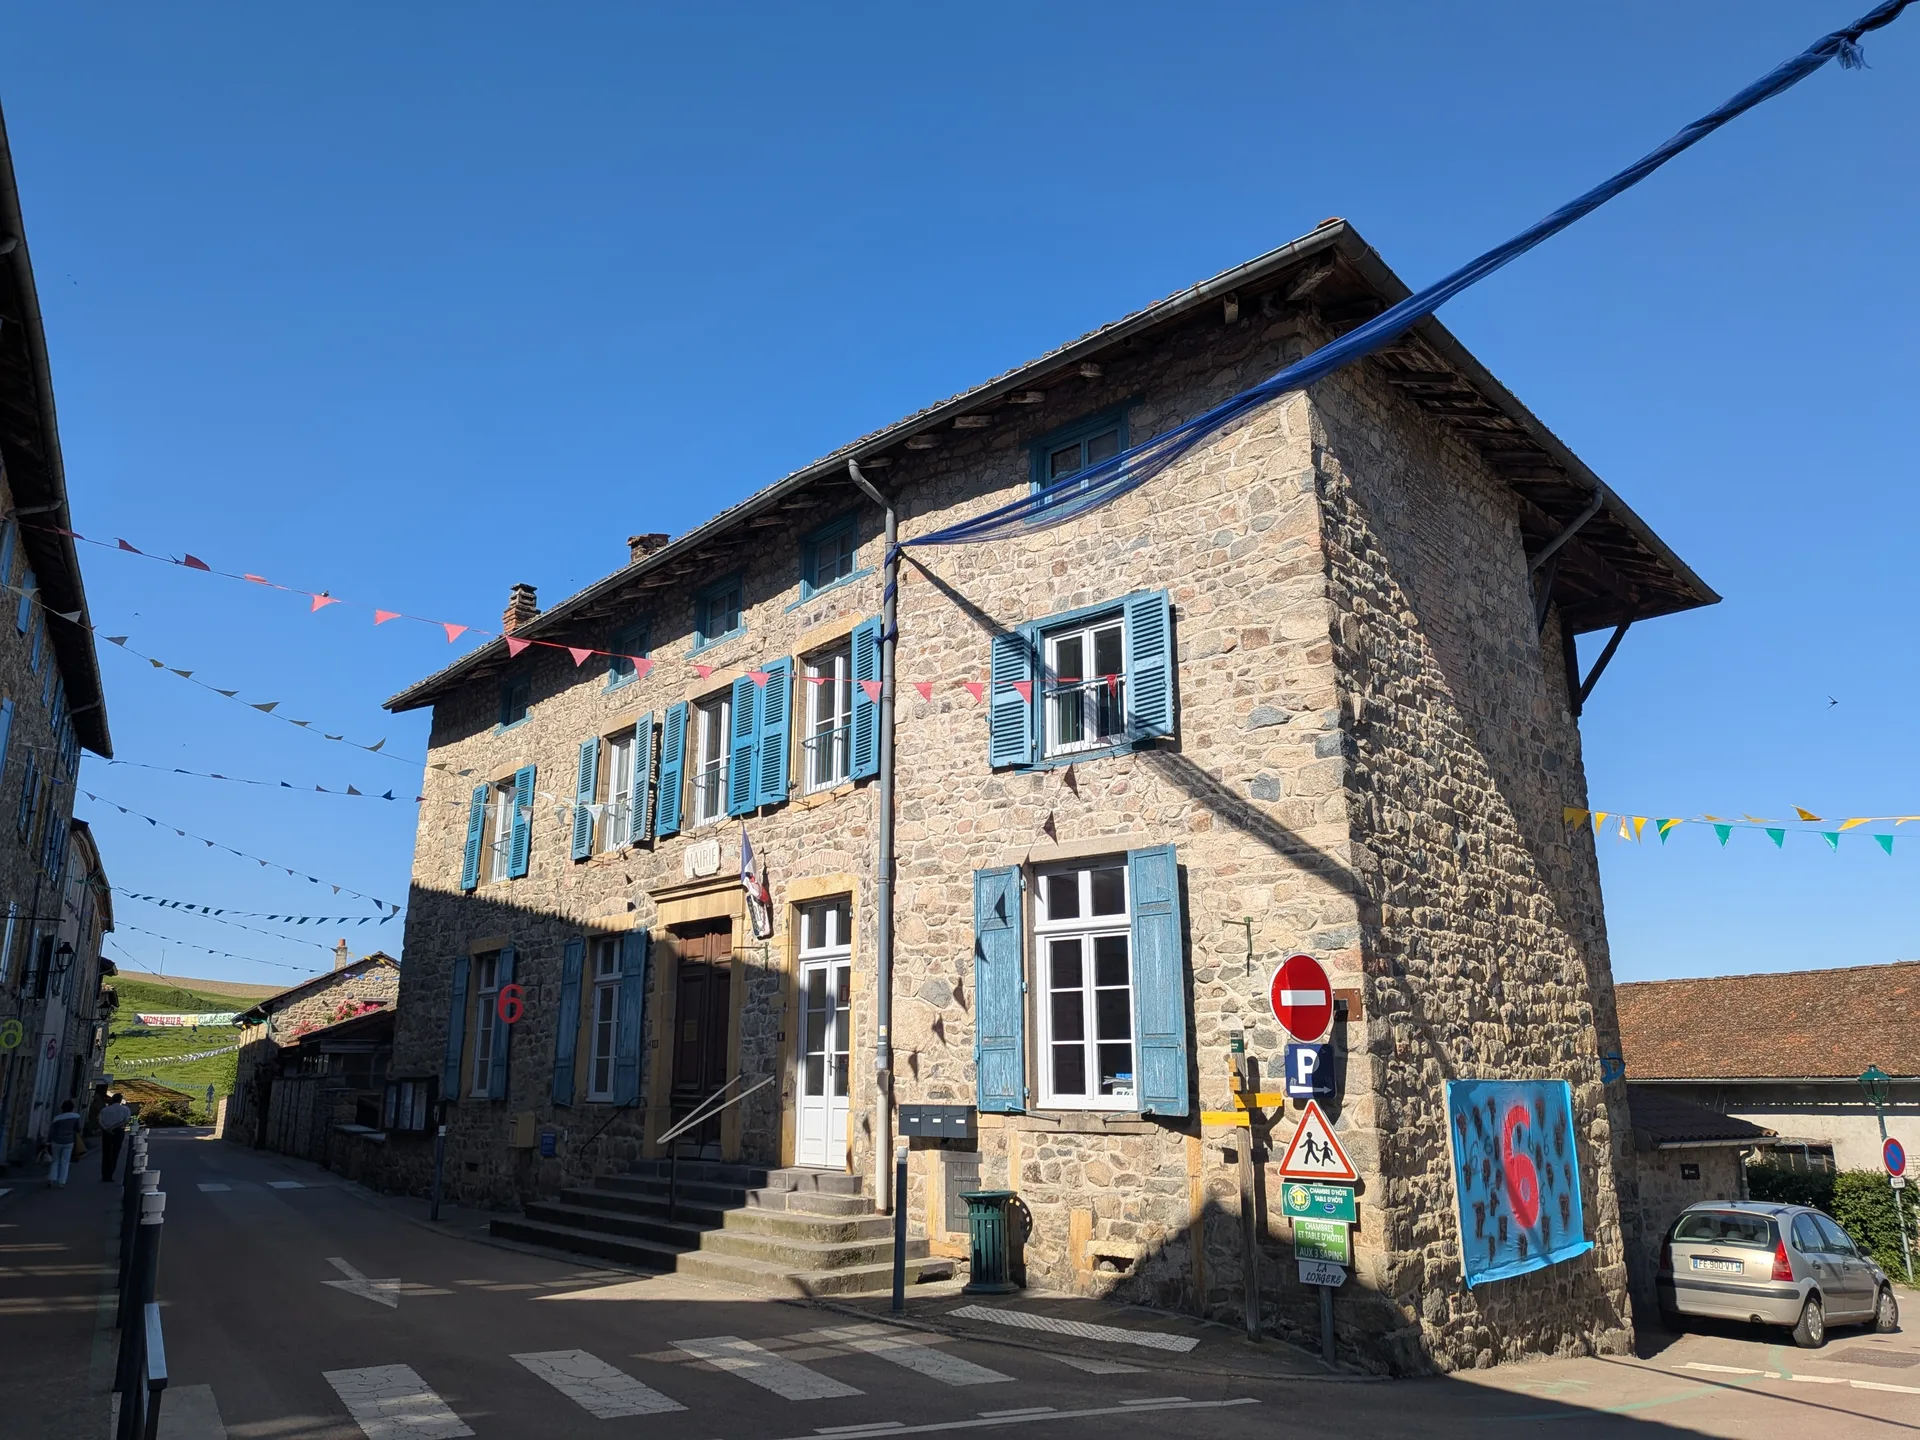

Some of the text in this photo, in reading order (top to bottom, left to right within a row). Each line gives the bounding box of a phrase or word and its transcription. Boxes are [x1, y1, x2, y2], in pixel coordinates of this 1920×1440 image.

[686, 847, 717, 869] MAIRIE
[498, 984, 524, 1024] 6
[1297, 1049, 1320, 1084] P
[1503, 1105, 1539, 1228] 6
[1309, 1187, 1347, 1196] CHAMBRE D'HÔTE
[1305, 1222, 1334, 1232] CHAMBRES
[1297, 1230, 1344, 1243] ET TABLE D'HÔTES
[1300, 1247, 1343, 1260] AUX 3 SAPINS
